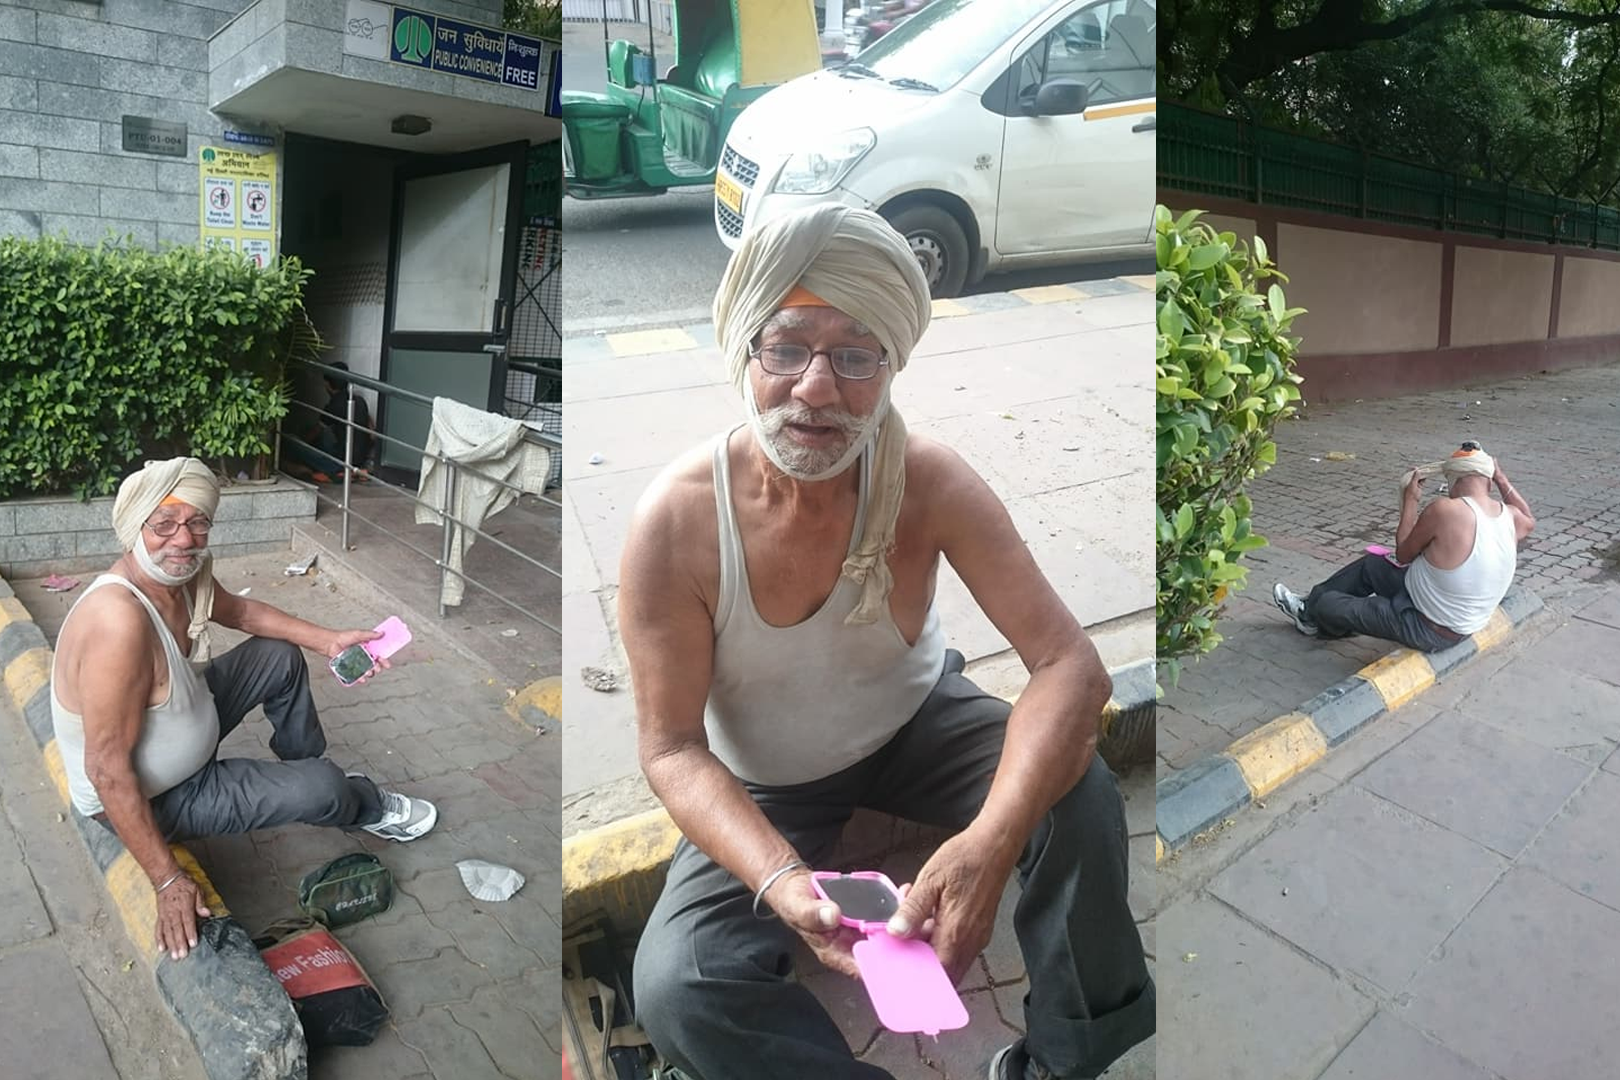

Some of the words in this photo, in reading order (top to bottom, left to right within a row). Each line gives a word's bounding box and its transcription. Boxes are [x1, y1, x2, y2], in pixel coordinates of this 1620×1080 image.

[437, 27, 457, 44] जन
[435, 49, 458, 68] PUBLIC
[459, 54, 503, 78] CONVENIENCE
[506, 66, 536, 86] FREE
